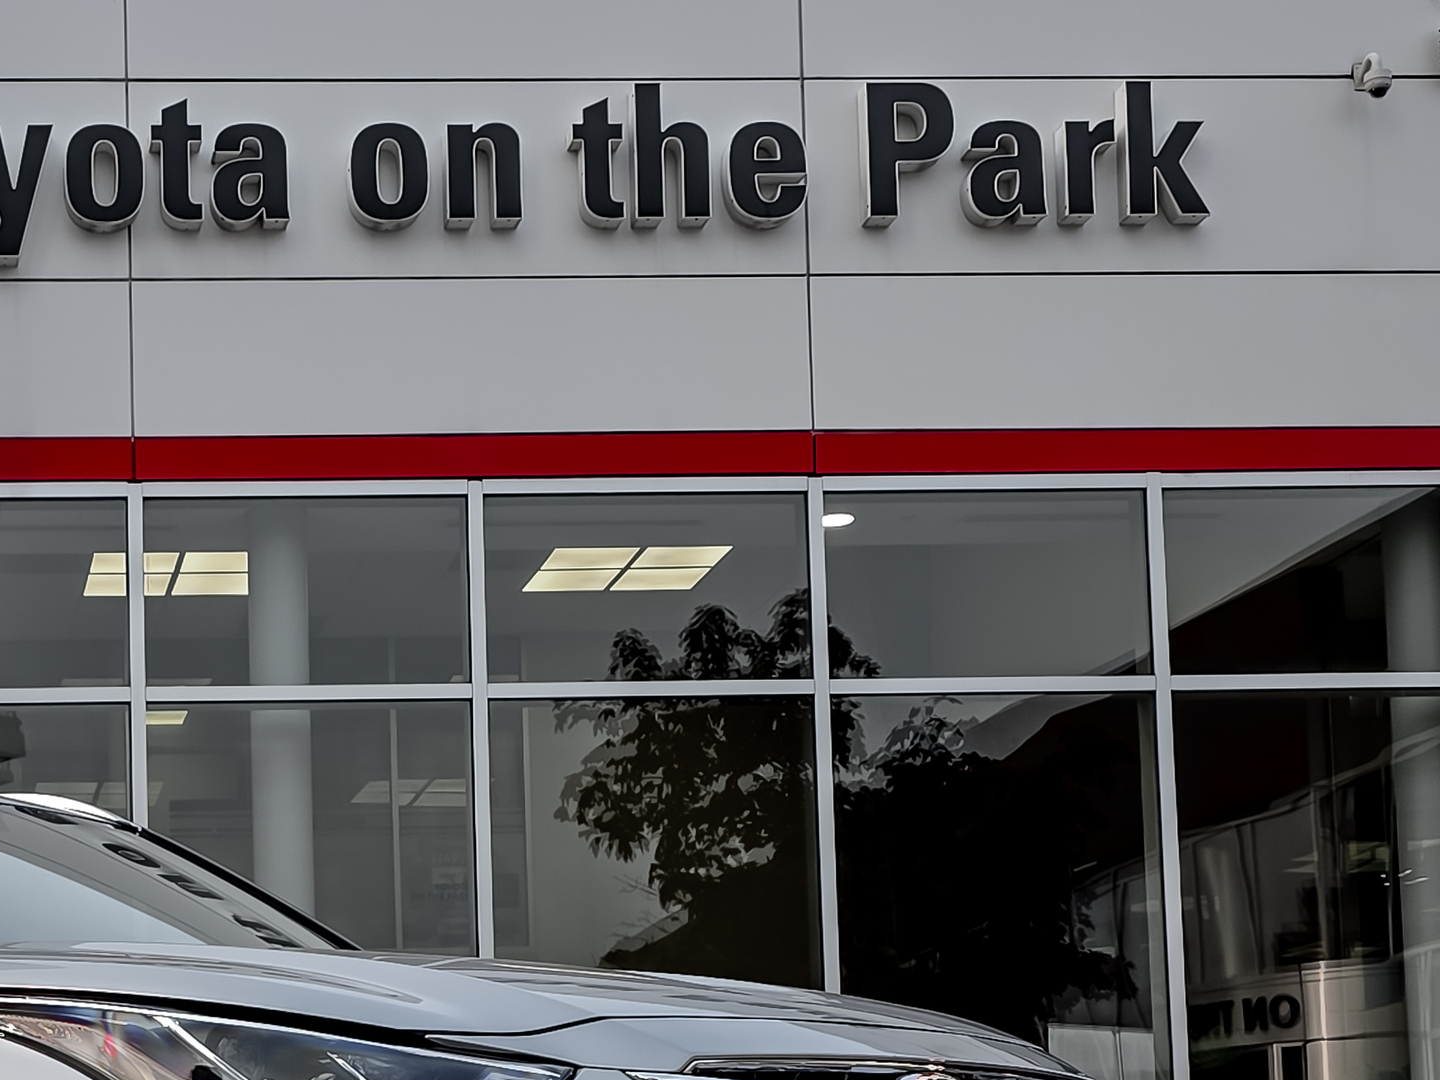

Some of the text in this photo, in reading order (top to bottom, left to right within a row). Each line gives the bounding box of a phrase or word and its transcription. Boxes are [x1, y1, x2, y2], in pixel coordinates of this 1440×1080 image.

[350, 121, 523, 230] on
[570, 82, 808, 229] the
[862, 81, 1212, 229] Park
